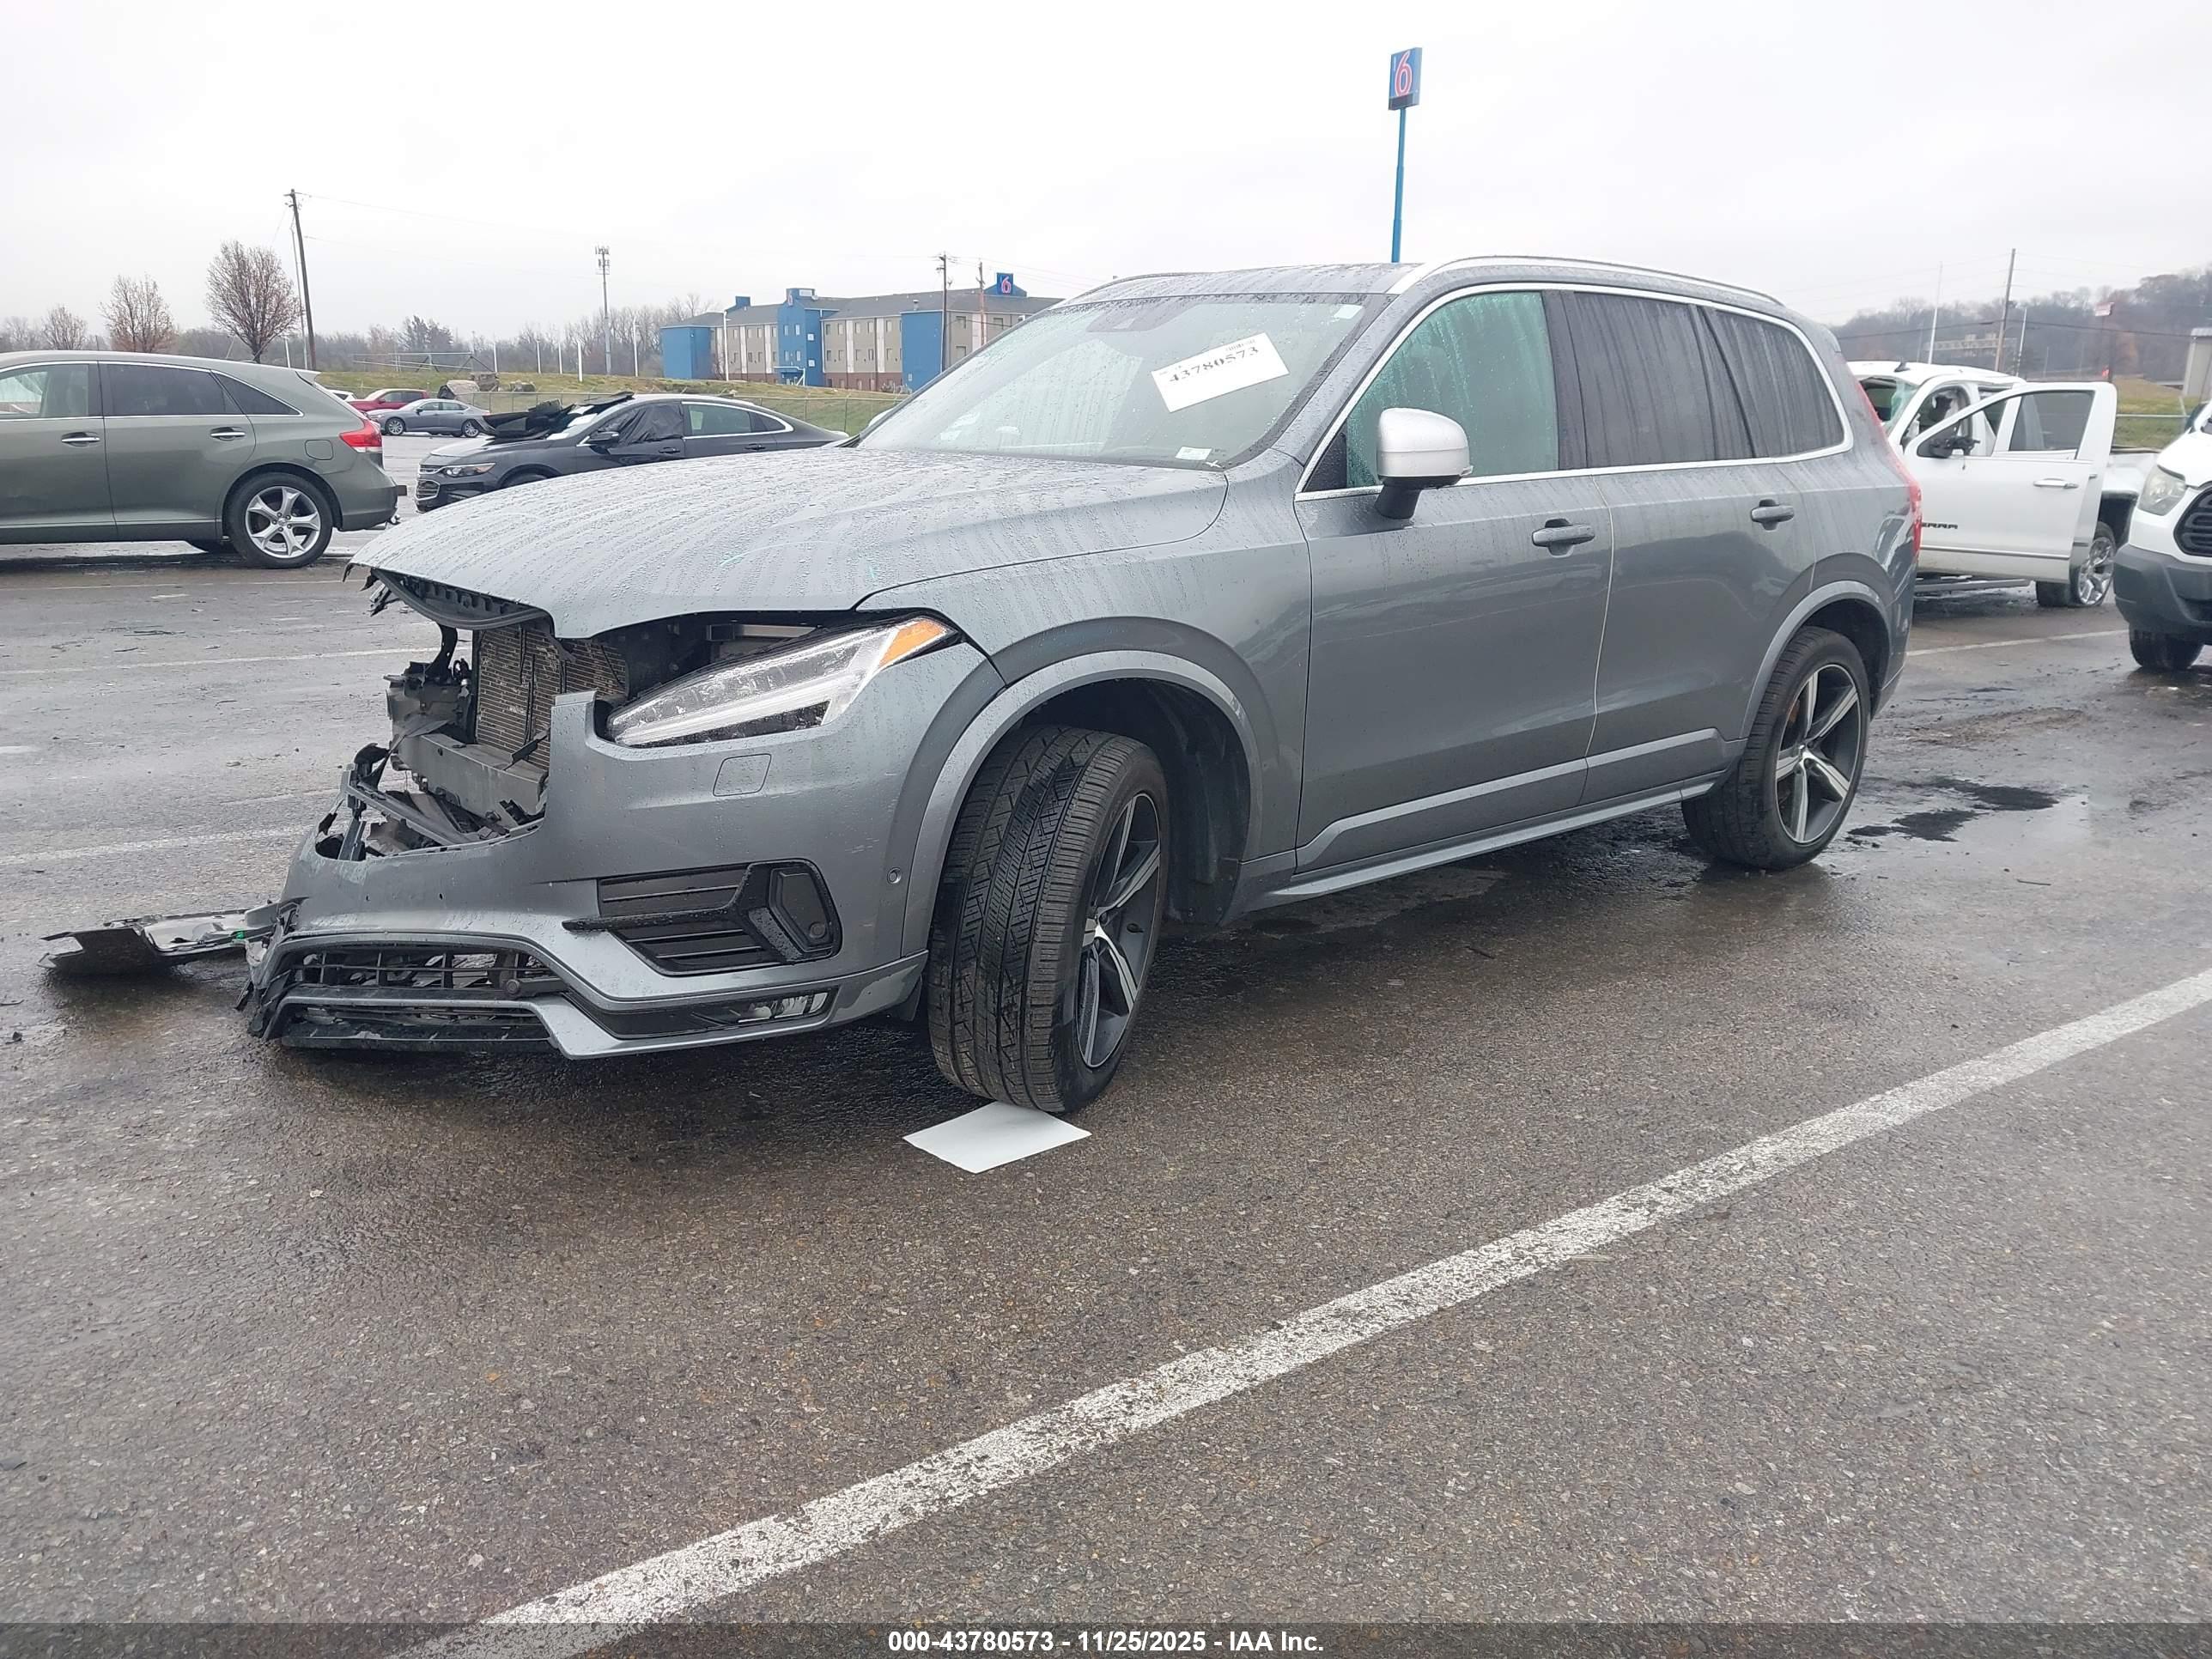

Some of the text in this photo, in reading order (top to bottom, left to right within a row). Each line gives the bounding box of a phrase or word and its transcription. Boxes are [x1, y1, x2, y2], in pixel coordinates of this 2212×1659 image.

[1395, 50, 1413, 96] 6
[1001, 276, 1012, 294] 6
[1169, 346, 1260, 382] 43780573
